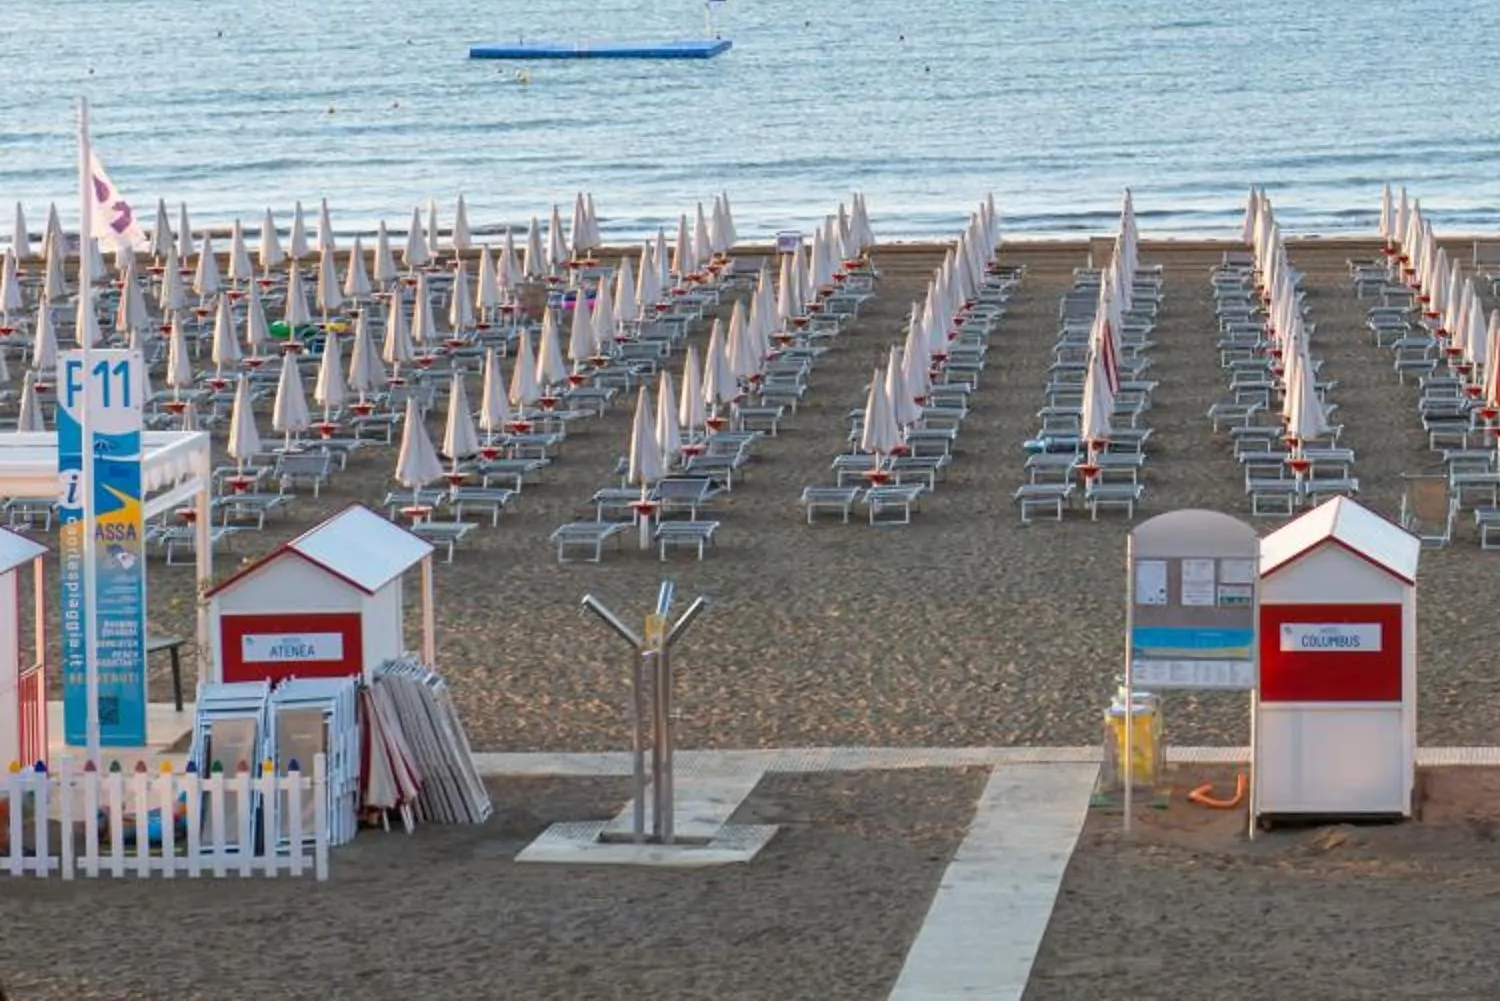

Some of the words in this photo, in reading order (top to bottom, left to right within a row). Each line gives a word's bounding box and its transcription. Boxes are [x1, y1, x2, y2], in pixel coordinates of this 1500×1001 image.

[94, 522, 138, 541] ASSA
[1301, 634, 1361, 648] COLUMBUS
[269, 645, 315, 658] ATENEA
